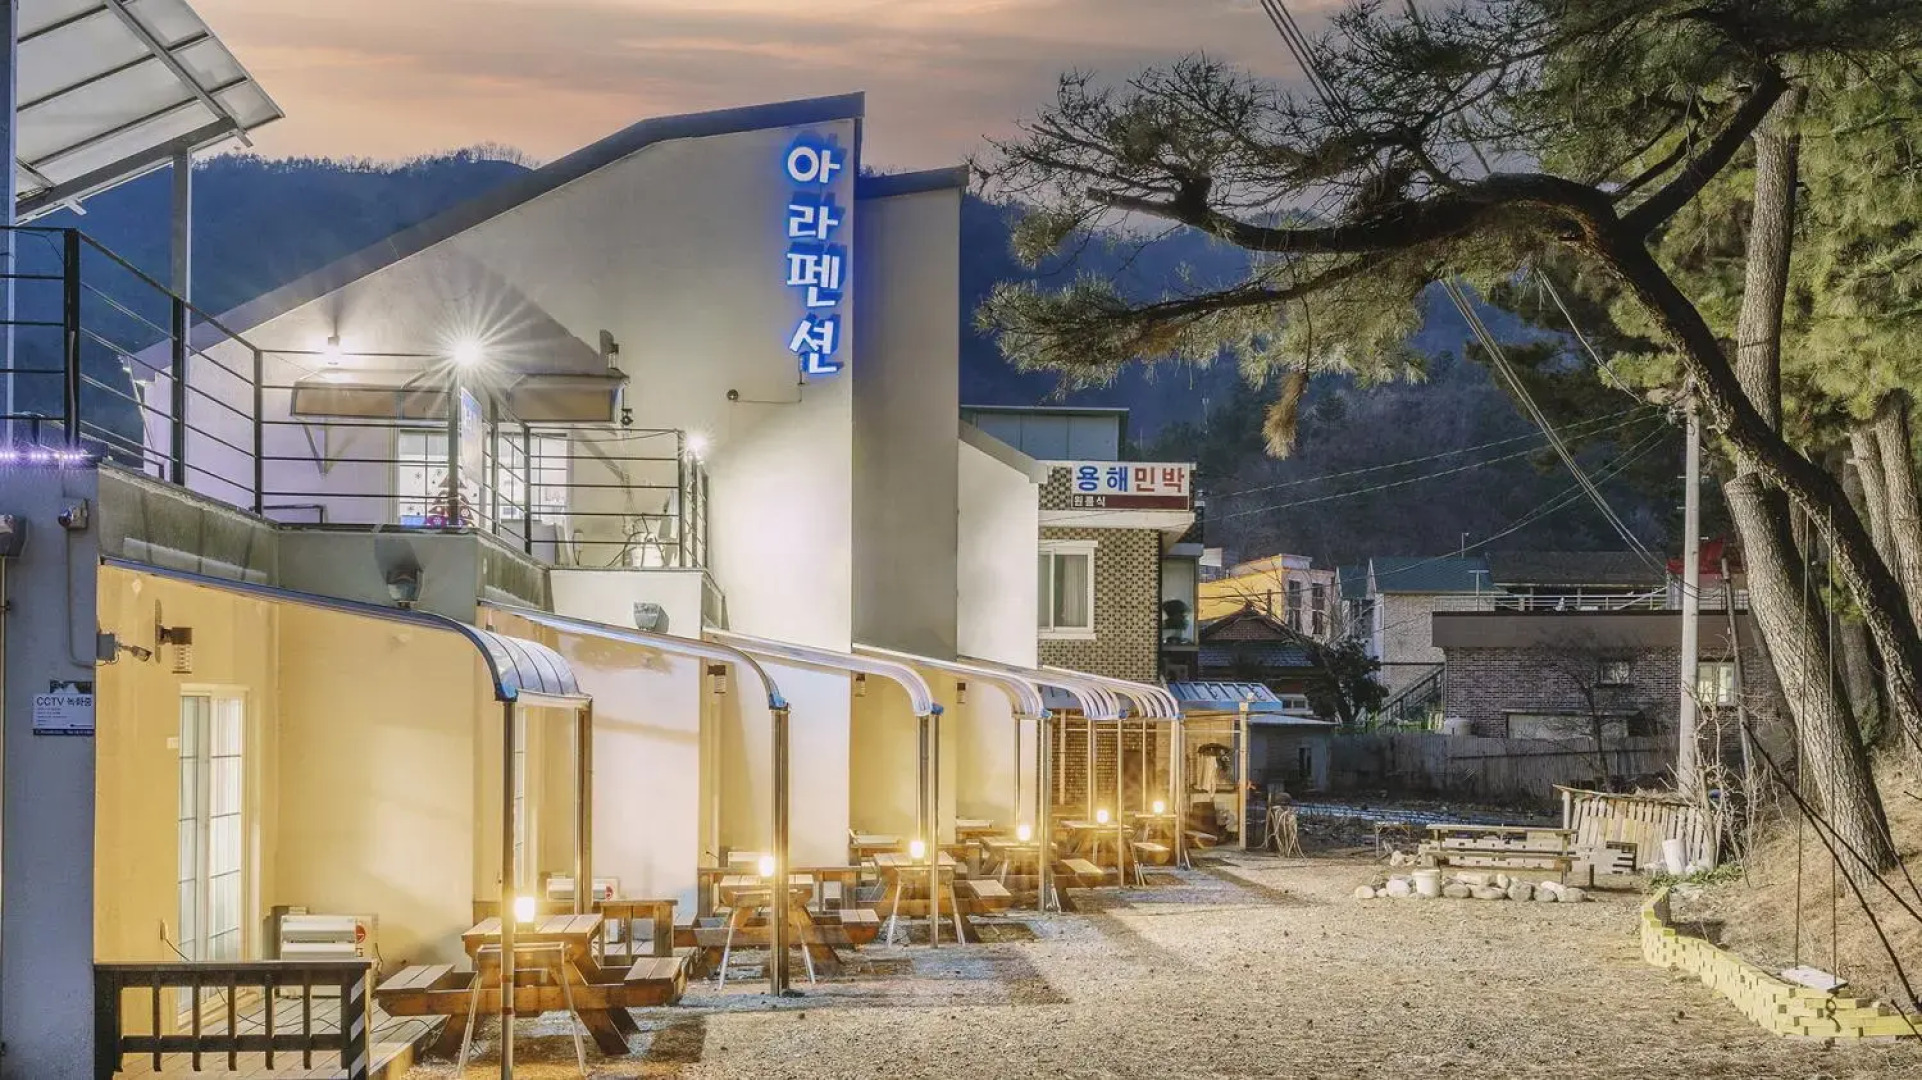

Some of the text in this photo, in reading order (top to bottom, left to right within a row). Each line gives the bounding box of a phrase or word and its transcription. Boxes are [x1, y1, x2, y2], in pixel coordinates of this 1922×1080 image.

[787, 146, 841, 374] 아라펜션
[1076, 465, 1185, 493] 용해민박
[36, 696, 92, 707] CCTV 녹화중
